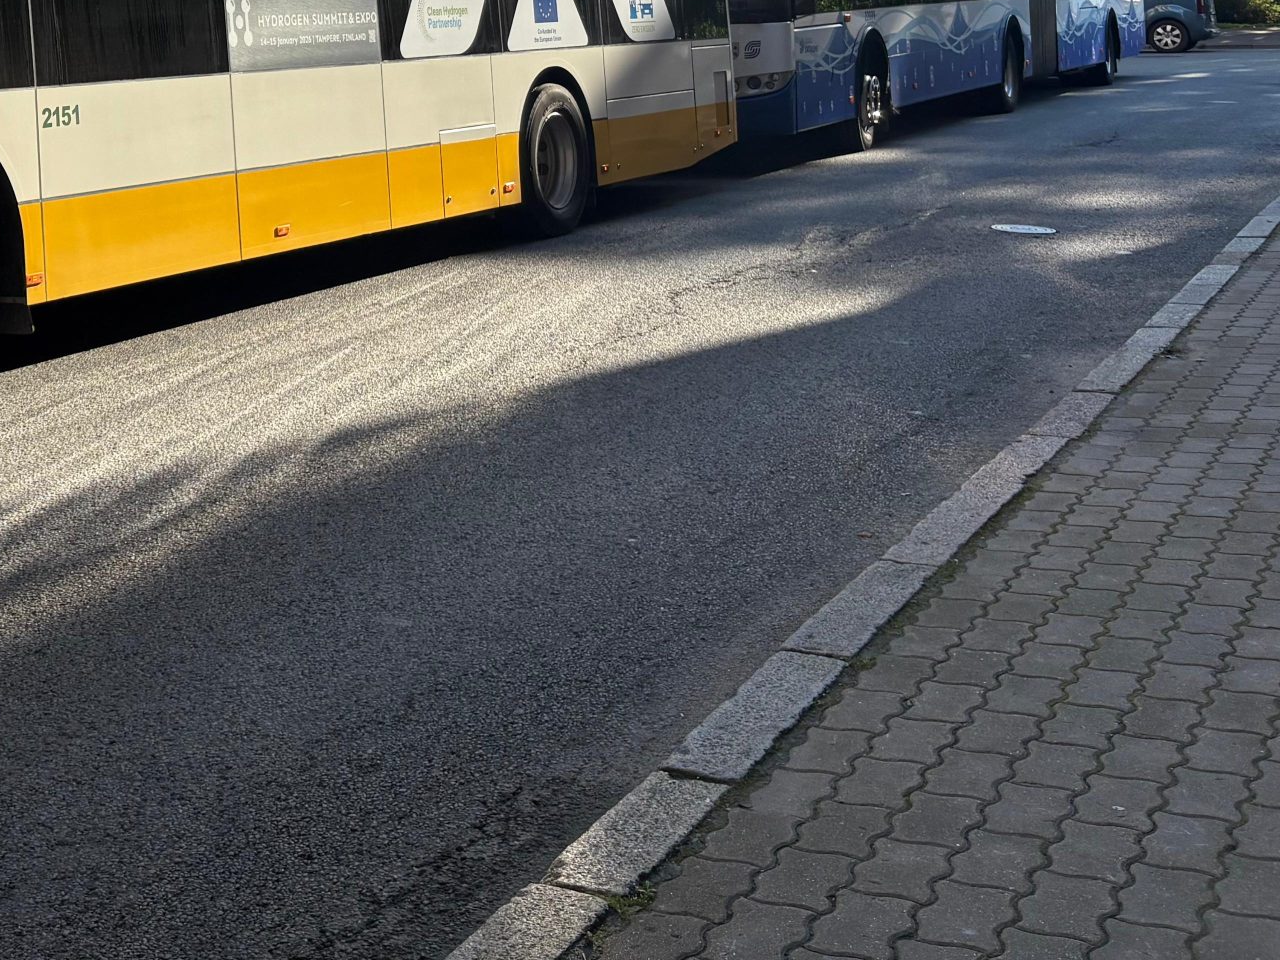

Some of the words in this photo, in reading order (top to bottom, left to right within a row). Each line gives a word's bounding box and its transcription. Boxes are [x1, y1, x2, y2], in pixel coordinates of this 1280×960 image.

[426, 6, 443, 17] Clean
[442, 5, 468, 18] Hydrogen
[258, 14, 309, 27] HYDROGEN
[312, 12, 347, 25] SUMMIT
[355, 11, 377, 24] EXPO
[428, 17, 462, 30] Partnership
[315, 33, 342, 44] TAMPERE,
[342, 32, 367, 42] FINLAND
[42, 104, 80, 128] 2151
